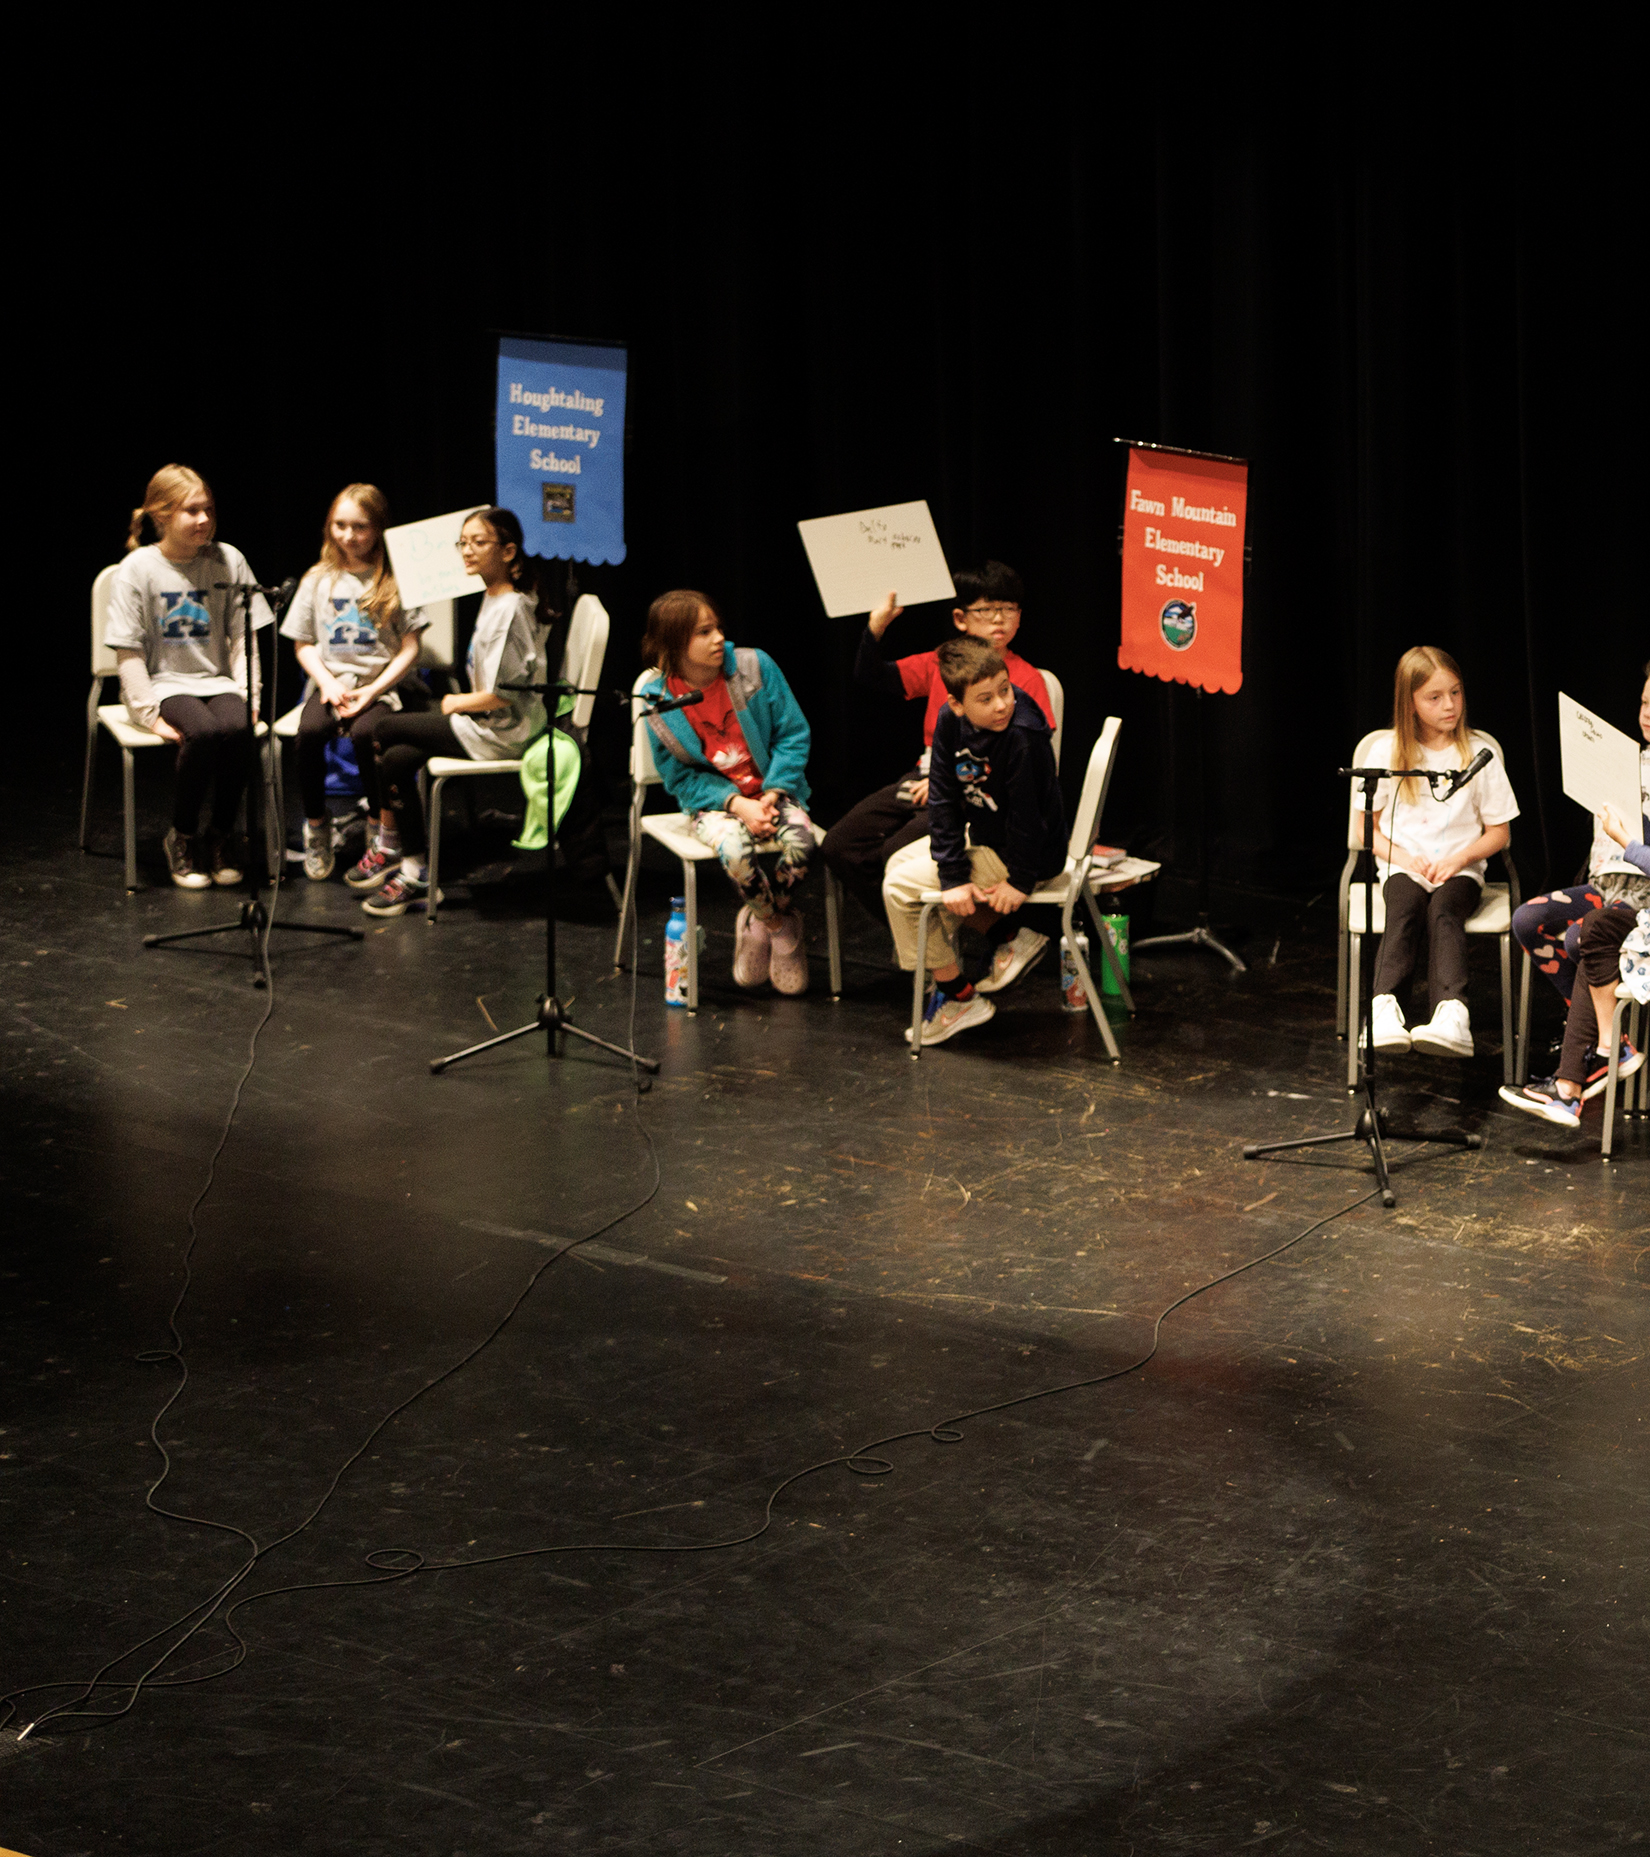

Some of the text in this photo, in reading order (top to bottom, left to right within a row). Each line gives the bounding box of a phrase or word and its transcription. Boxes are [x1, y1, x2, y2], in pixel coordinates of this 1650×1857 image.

[509, 382, 605, 417] Houghtaling
[512, 414, 601, 449] Elementary
[530, 448, 581, 475] School
[1130, 489, 1237, 527] Fawn Mountain
[1144, 526, 1225, 568] Elementary
[1155, 563, 1204, 592] School
